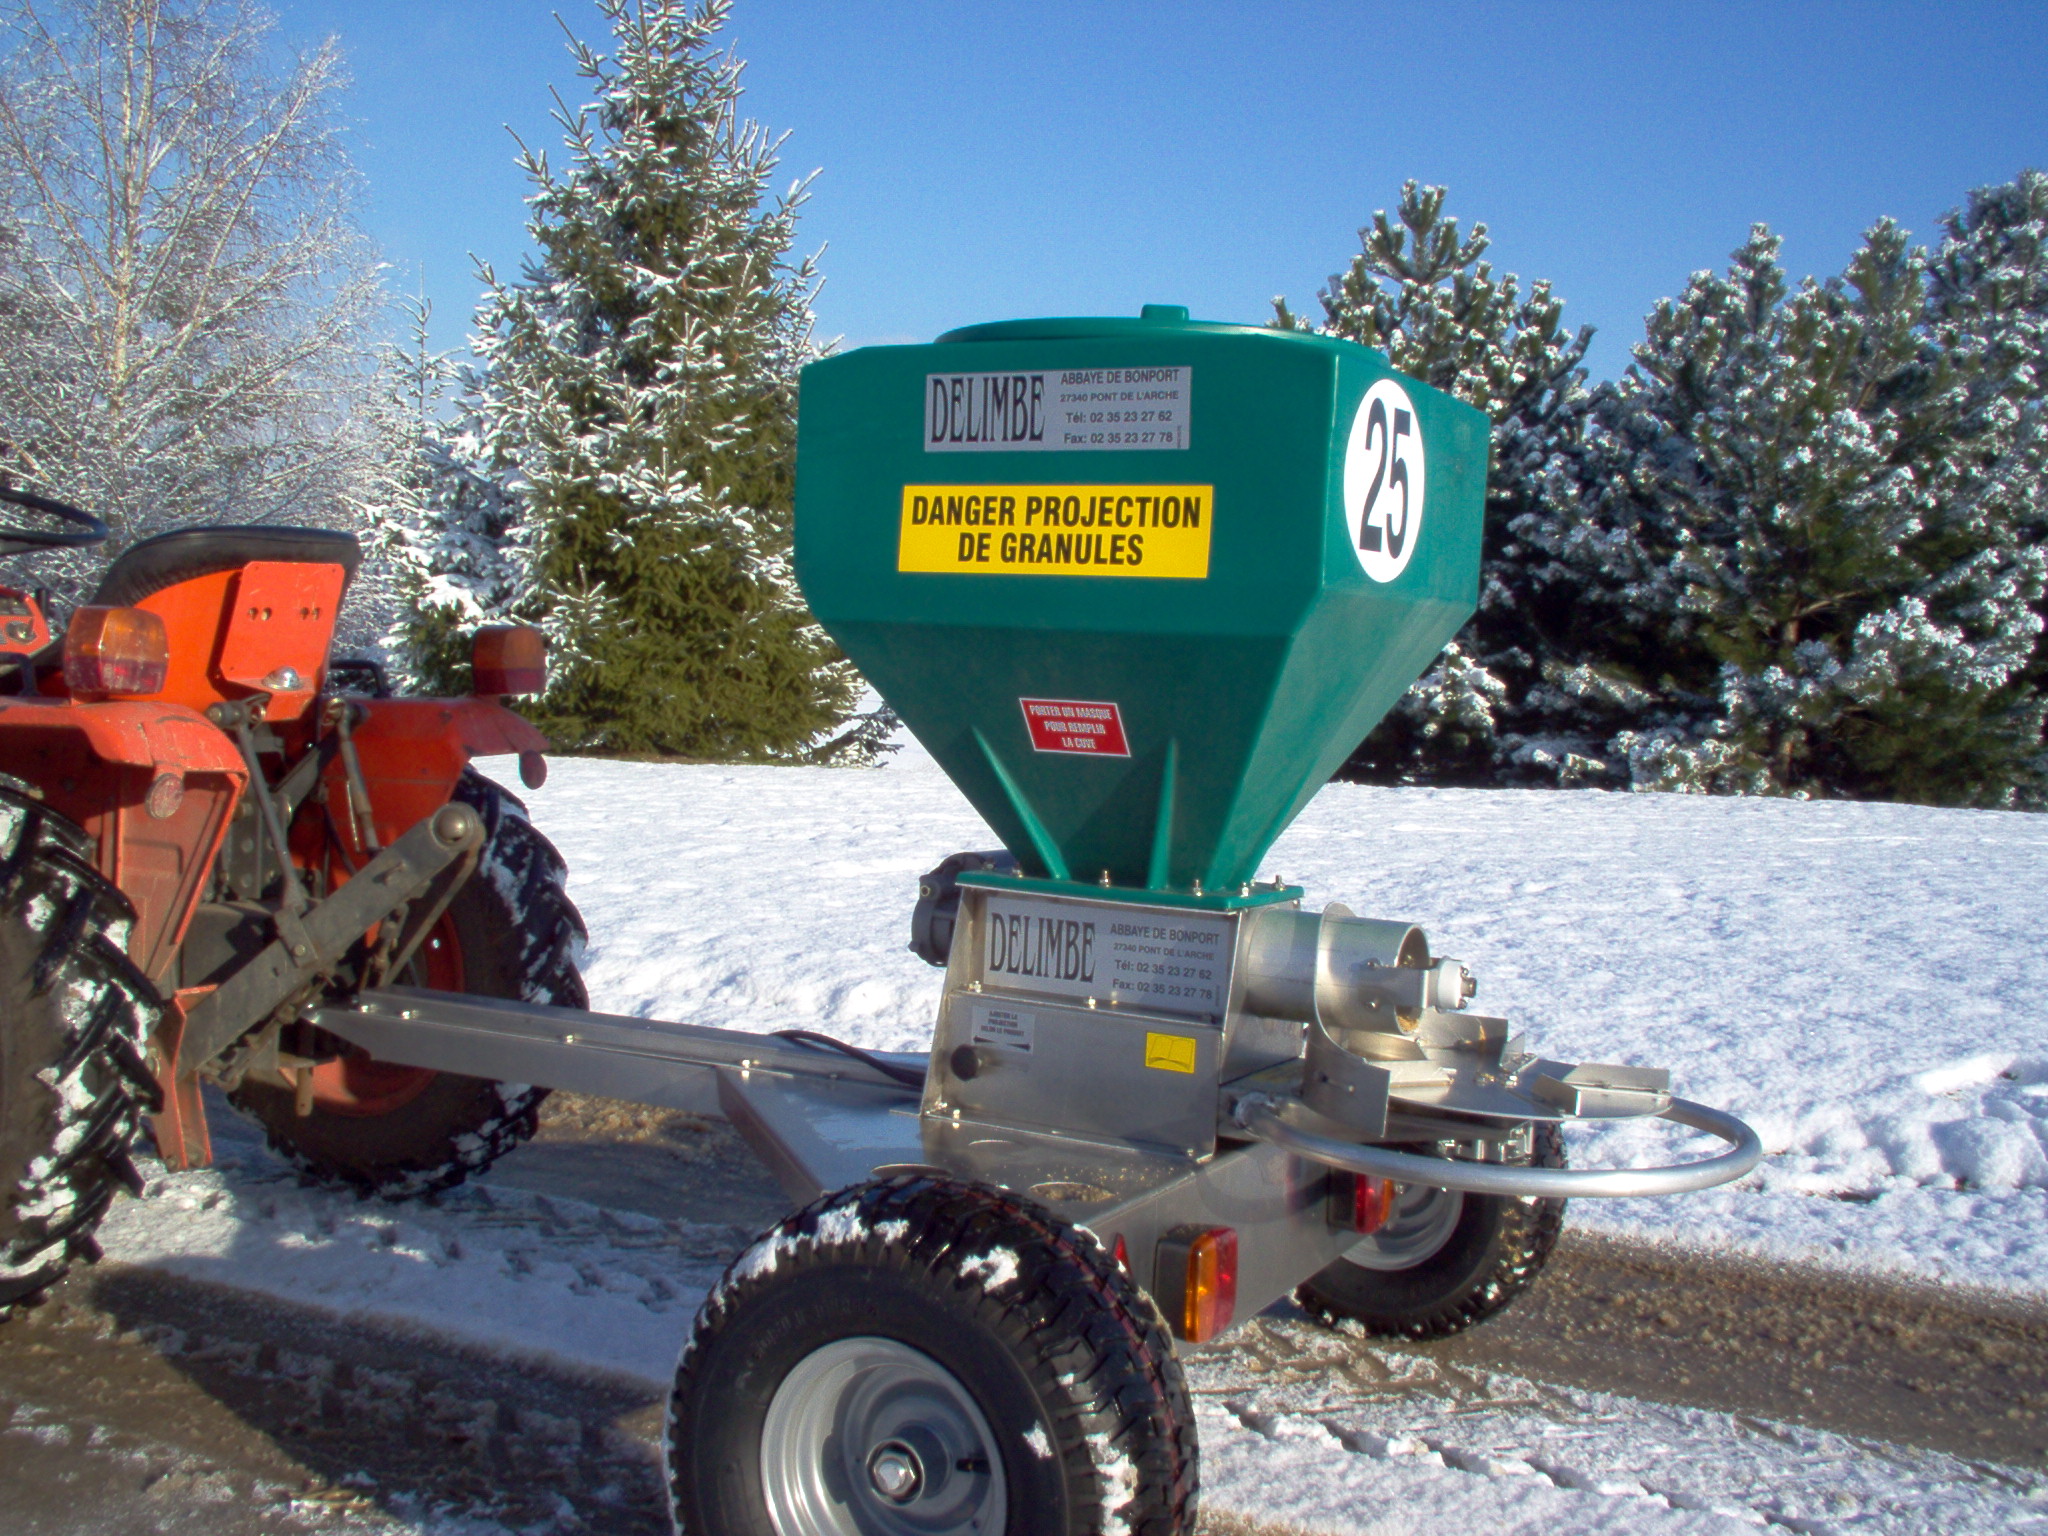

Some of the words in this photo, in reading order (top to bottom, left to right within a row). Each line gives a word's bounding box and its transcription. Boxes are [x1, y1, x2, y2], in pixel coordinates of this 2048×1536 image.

[1060, 372, 1105, 385] ABBAYE
[1106, 371, 1121, 384] DE
[1124, 369, 1179, 383] BONPORT
[1060, 393, 1088, 402] 27340
[1091, 392, 1118, 402] PONT
[1120, 392, 1134, 401] DE
[1136, 390, 1179, 400] L'ARCHE
[931, 374, 1045, 443] DELIMBE
[1066, 411, 1087, 423] Tél:
[1090, 413, 1104, 423] 02
[1106, 412, 1121, 423] 35
[1124, 411, 1138, 422] 23
[1141, 411, 1155, 422] 27
[1064, 433, 1087, 444] Fax:
[1090, 433, 1104, 444] 02
[1107, 433, 1121, 444] 35
[1125, 432, 1139, 443] 23
[1141, 432, 1155, 443] 27
[1160, 431, 1173, 443] 78
[1359, 397, 1411, 559] 25
[911, 495, 1016, 526] DANGER
[1025, 496, 1201, 528] PROJECTION
[957, 532, 991, 562] DE
[1000, 532, 1144, 566] GRANULES
[1029, 705, 1061, 717] PORTER
[1062, 707, 1075, 718] UN
[1076, 708, 1112, 720] MASQUE
[1044, 721, 1067, 732] POUR
[1068, 722, 1106, 735] REMPLIR
[1062, 737, 1074, 748] LA
[1075, 738, 1097, 749] CUVE
[1110, 923, 1150, 938] ABBAYE
[1152, 927, 1167, 940] DE
[1169, 929, 1220, 945] BONPORT
[989, 911, 1096, 983] DELIMBE
[1138, 945, 1161, 955] PONT
[1163, 948, 1175, 957] DE
[1177, 949, 1215, 961] L'ARCHE
[1115, 959, 1134, 971] Tél:
[1136, 962, 1149, 973] 02
[1152, 964, 1165, 975] 35
[1167, 965, 1180, 976] 23
[1183, 967, 1196, 978] 27
[1112, 978, 1134, 990] Fax:
[1137, 981, 1150, 993] 02
[1152, 983, 1165, 995] 35
[1168, 985, 1181, 996] 23
[1183, 986, 1197, 998] 27
[1199, 988, 1213, 1000] 78
